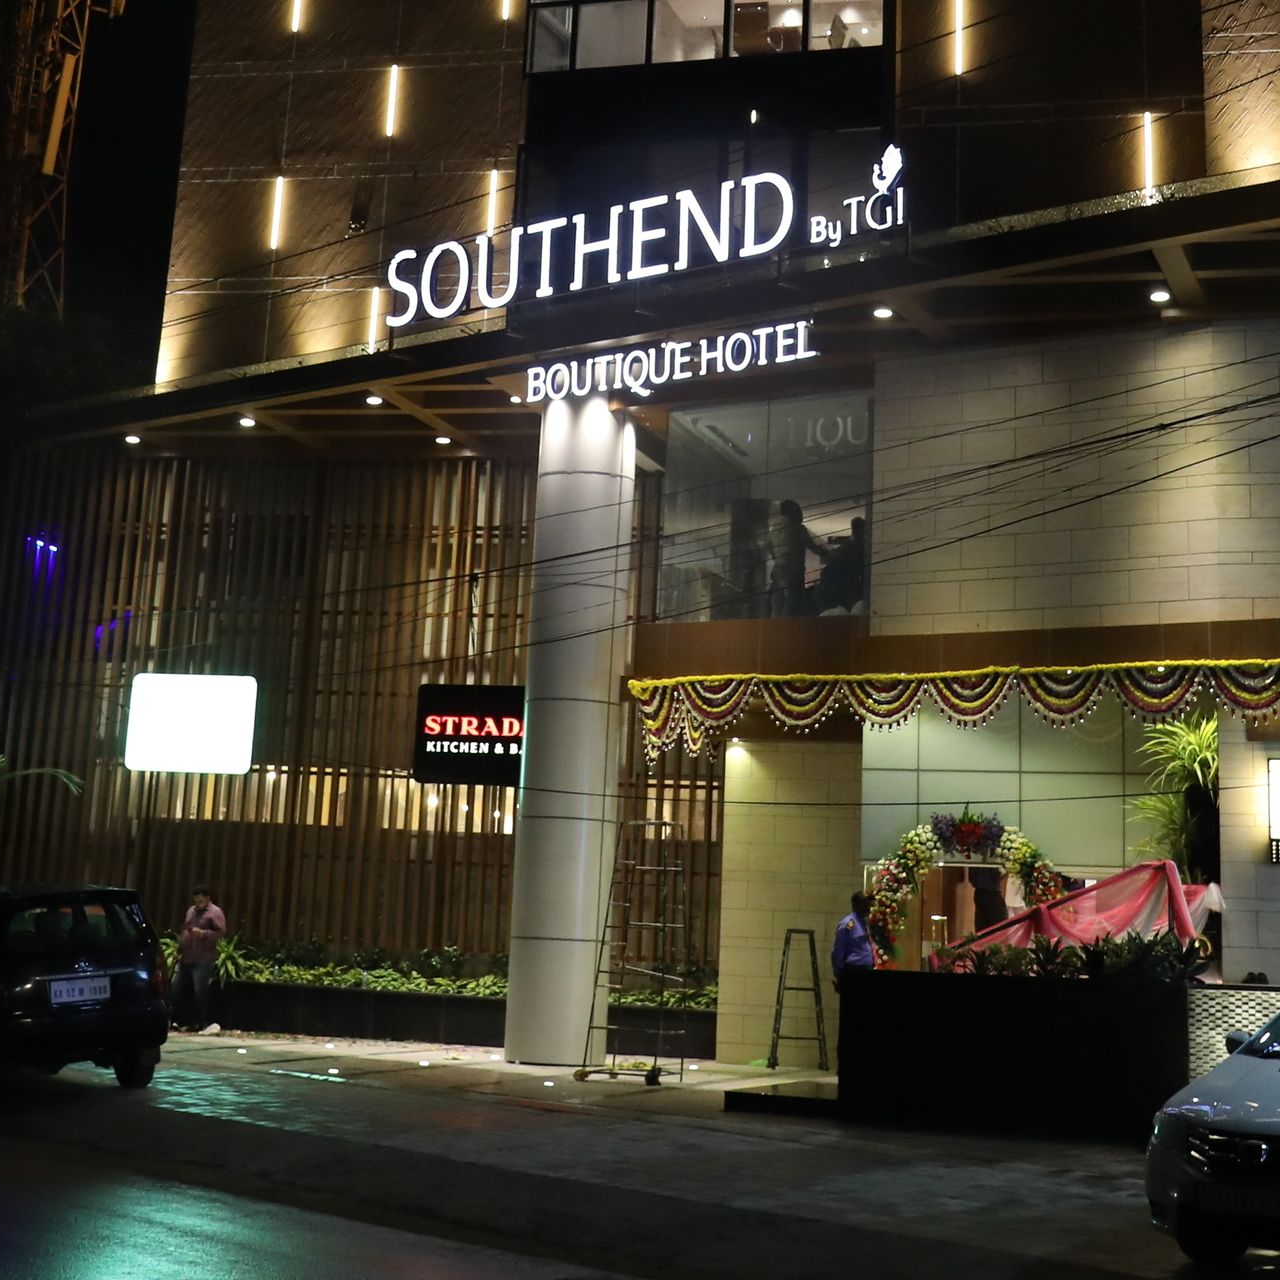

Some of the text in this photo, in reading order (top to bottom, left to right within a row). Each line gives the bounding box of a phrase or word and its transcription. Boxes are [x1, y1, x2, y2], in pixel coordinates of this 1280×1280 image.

[385, 171, 904, 327] SOUTHEND By TGI
[526, 321, 817, 403] BOUTIQUE HOTEL
[424, 715, 525, 737] STRAD
[426, 740, 489, 754] KITCHEN
[493, 742, 505, 755] &
